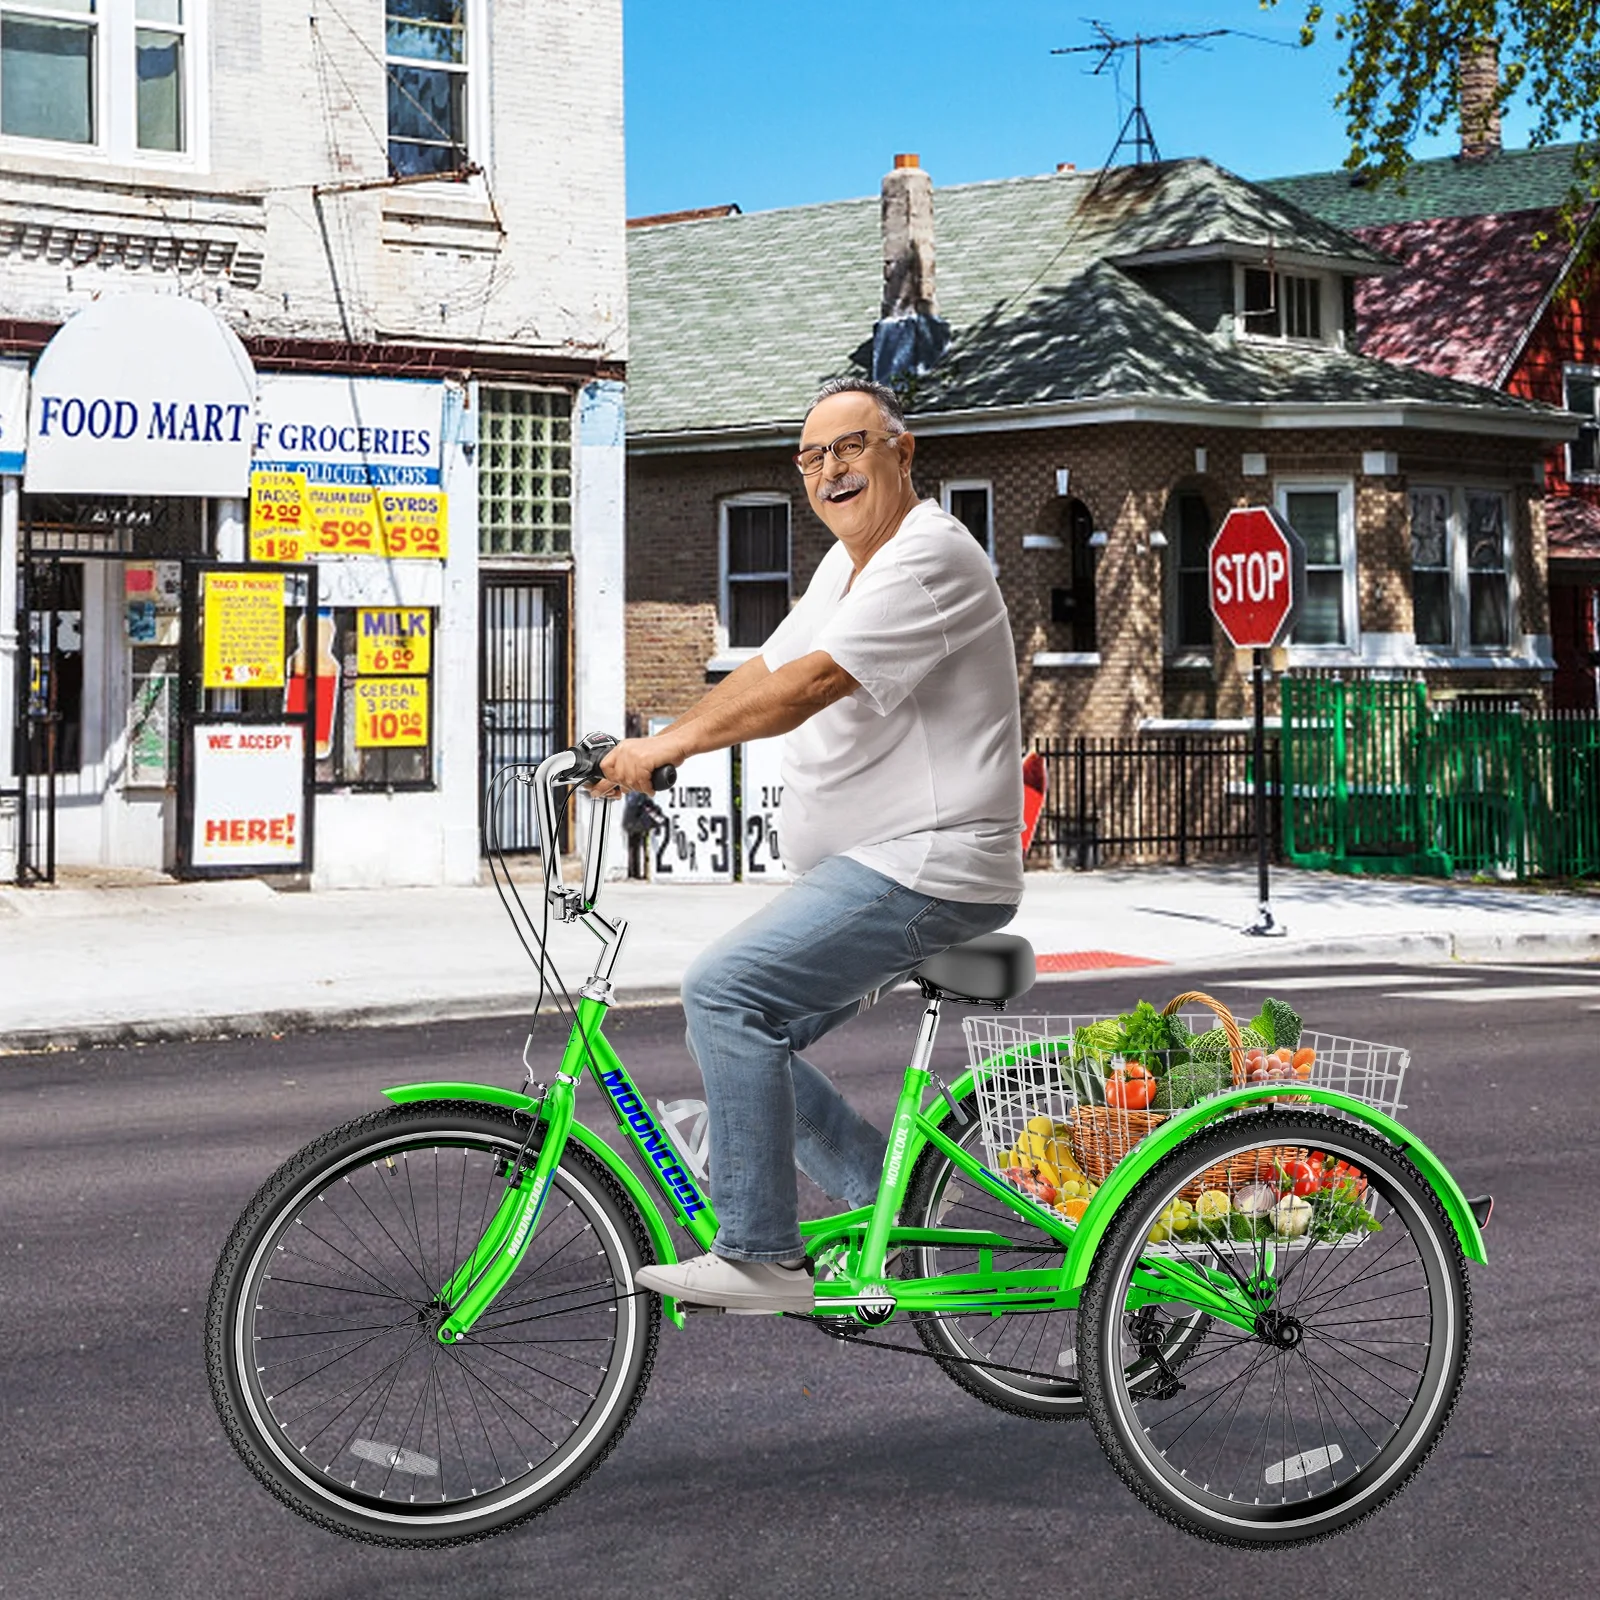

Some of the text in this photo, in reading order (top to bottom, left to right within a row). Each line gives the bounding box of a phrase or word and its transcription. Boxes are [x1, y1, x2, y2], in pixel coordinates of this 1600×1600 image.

[39, 396, 138, 439] FOOD
[147, 401, 249, 441] MART
[278, 424, 430, 457] GROCERIES
[257, 489, 301, 503] TACOS
[383, 496, 438, 514] GYROS
[1215, 551, 1284, 604] STOP
[363, 612, 426, 636] MILK
[360, 683, 419, 698] CEREAL
[367, 699, 409, 713] 3 FOR
[208, 735, 292, 750] WE ACCEPT
[679, 787, 712, 808] LITER
[206, 813, 295, 845] HERE!
[747, 815, 766, 873] 2
[601, 1068, 707, 1221] MOONCOOL
[885, 1127, 909, 1188] MOONCOOL
[507, 1175, 547, 1258] MOONCOOL
